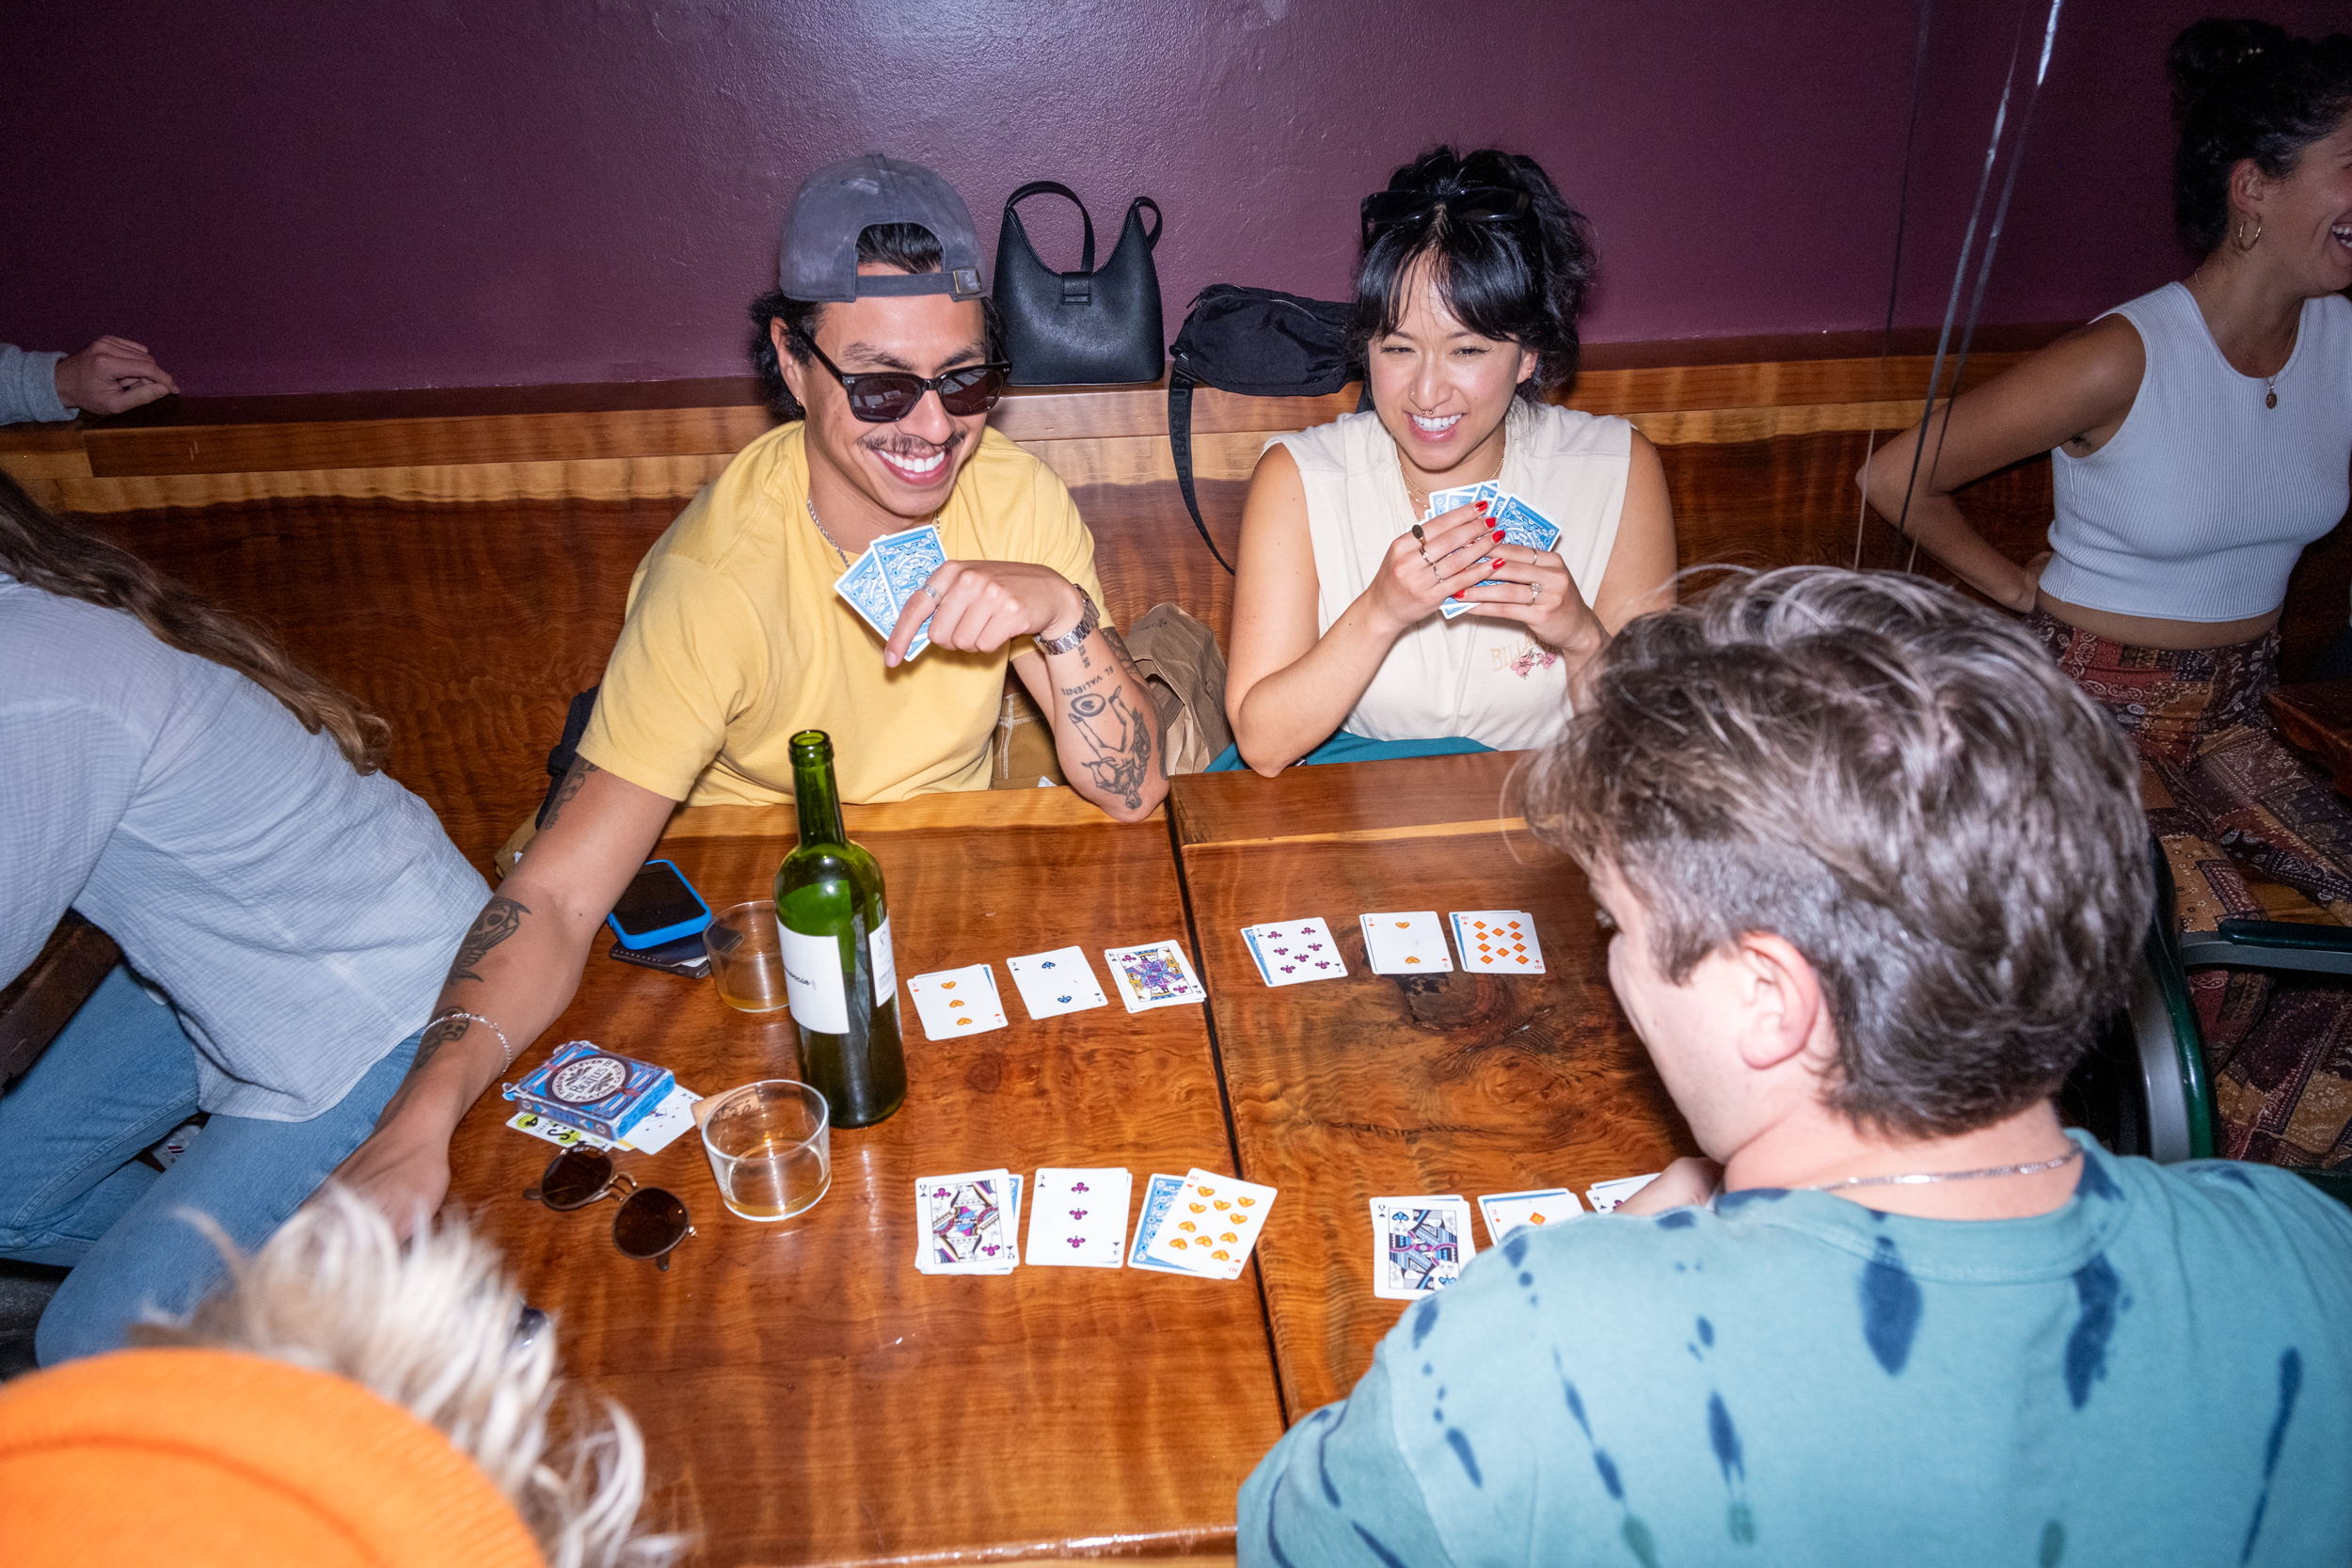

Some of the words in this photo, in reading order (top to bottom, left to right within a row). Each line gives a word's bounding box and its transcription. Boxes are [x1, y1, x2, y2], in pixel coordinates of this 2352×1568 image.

[1104, 666, 1114, 675] EL
[1061, 675, 1103, 695] VALIENTE
[554, 1072, 567, 1095] THEORY
[568, 1059, 603, 1071] ELEVEN
[569, 1067, 608, 1093] BEATLES
[576, 1085, 615, 1100] PLAYING
[612, 1064, 623, 1085] CARDS
